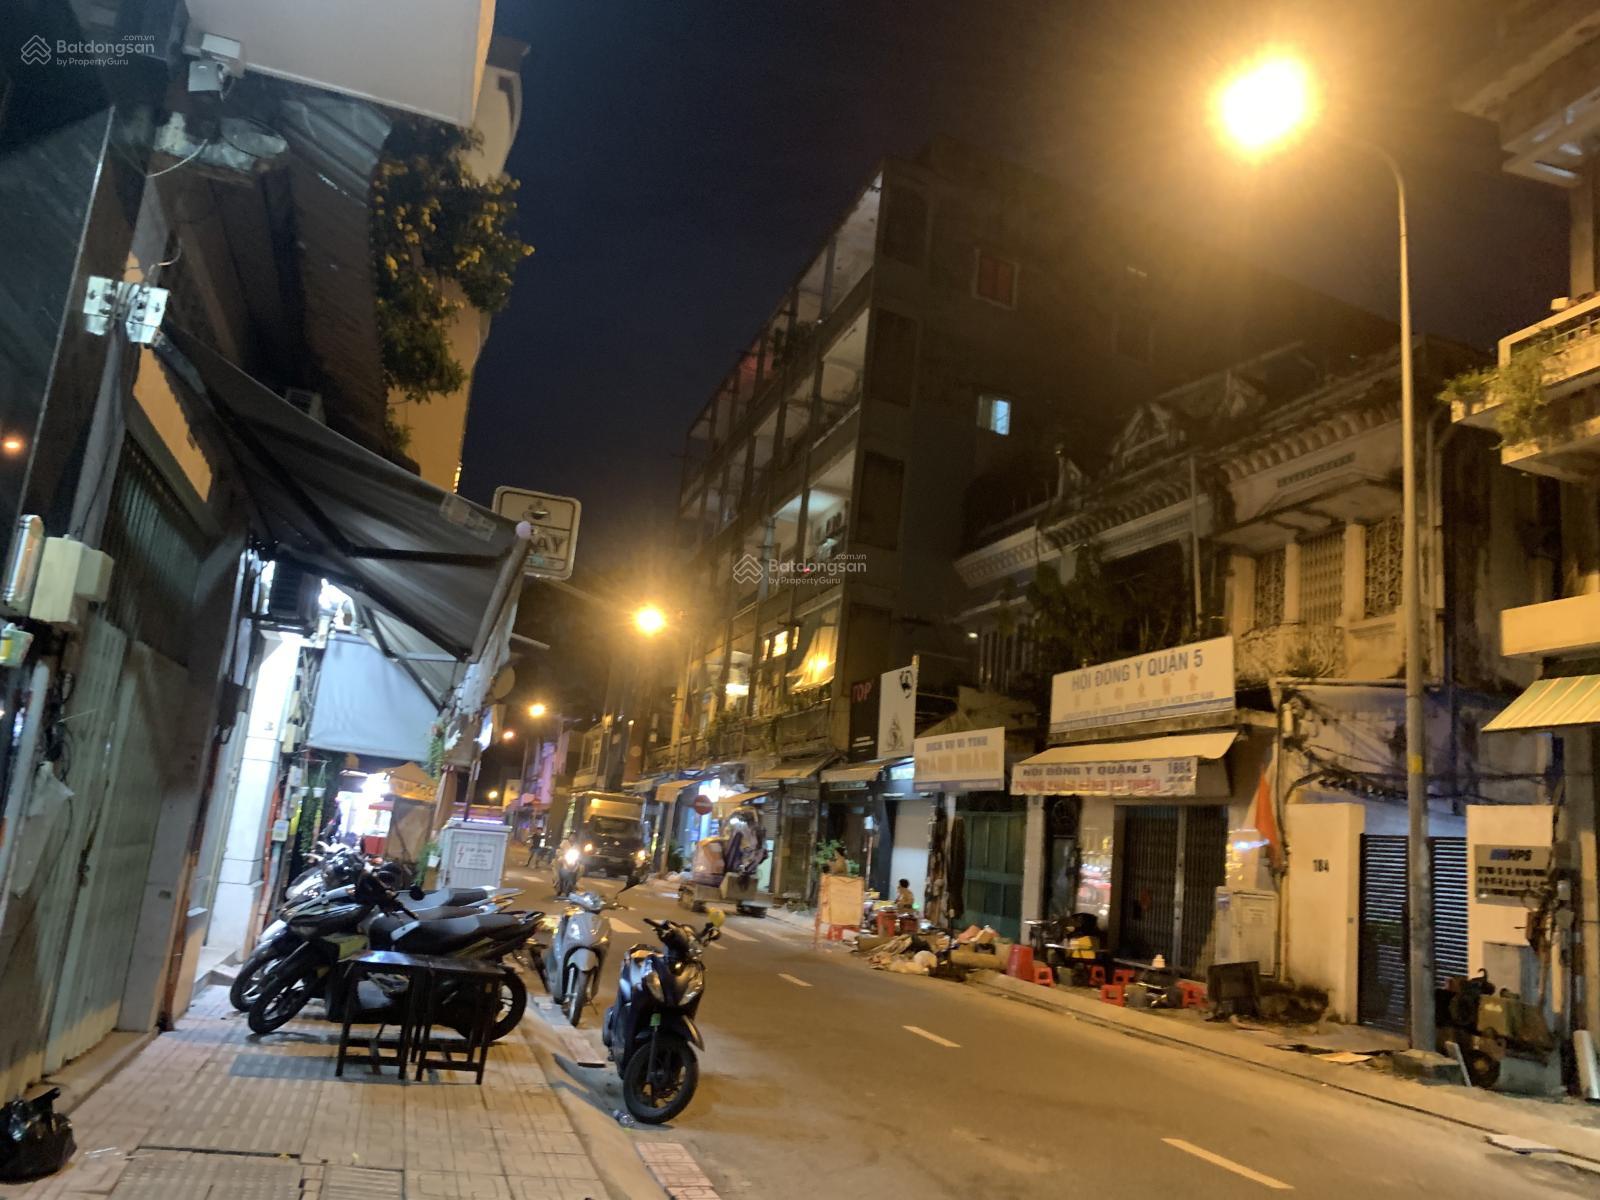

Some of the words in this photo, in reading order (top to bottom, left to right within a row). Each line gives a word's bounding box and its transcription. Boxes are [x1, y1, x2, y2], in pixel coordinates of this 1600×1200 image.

[1135, 661, 1145, 679] Y
[1148, 650, 1189, 677] QUẬN
[1194, 649, 1204, 668] 5
[1085, 766, 1092, 775] Y
[1142, 764, 1151, 774] 5
